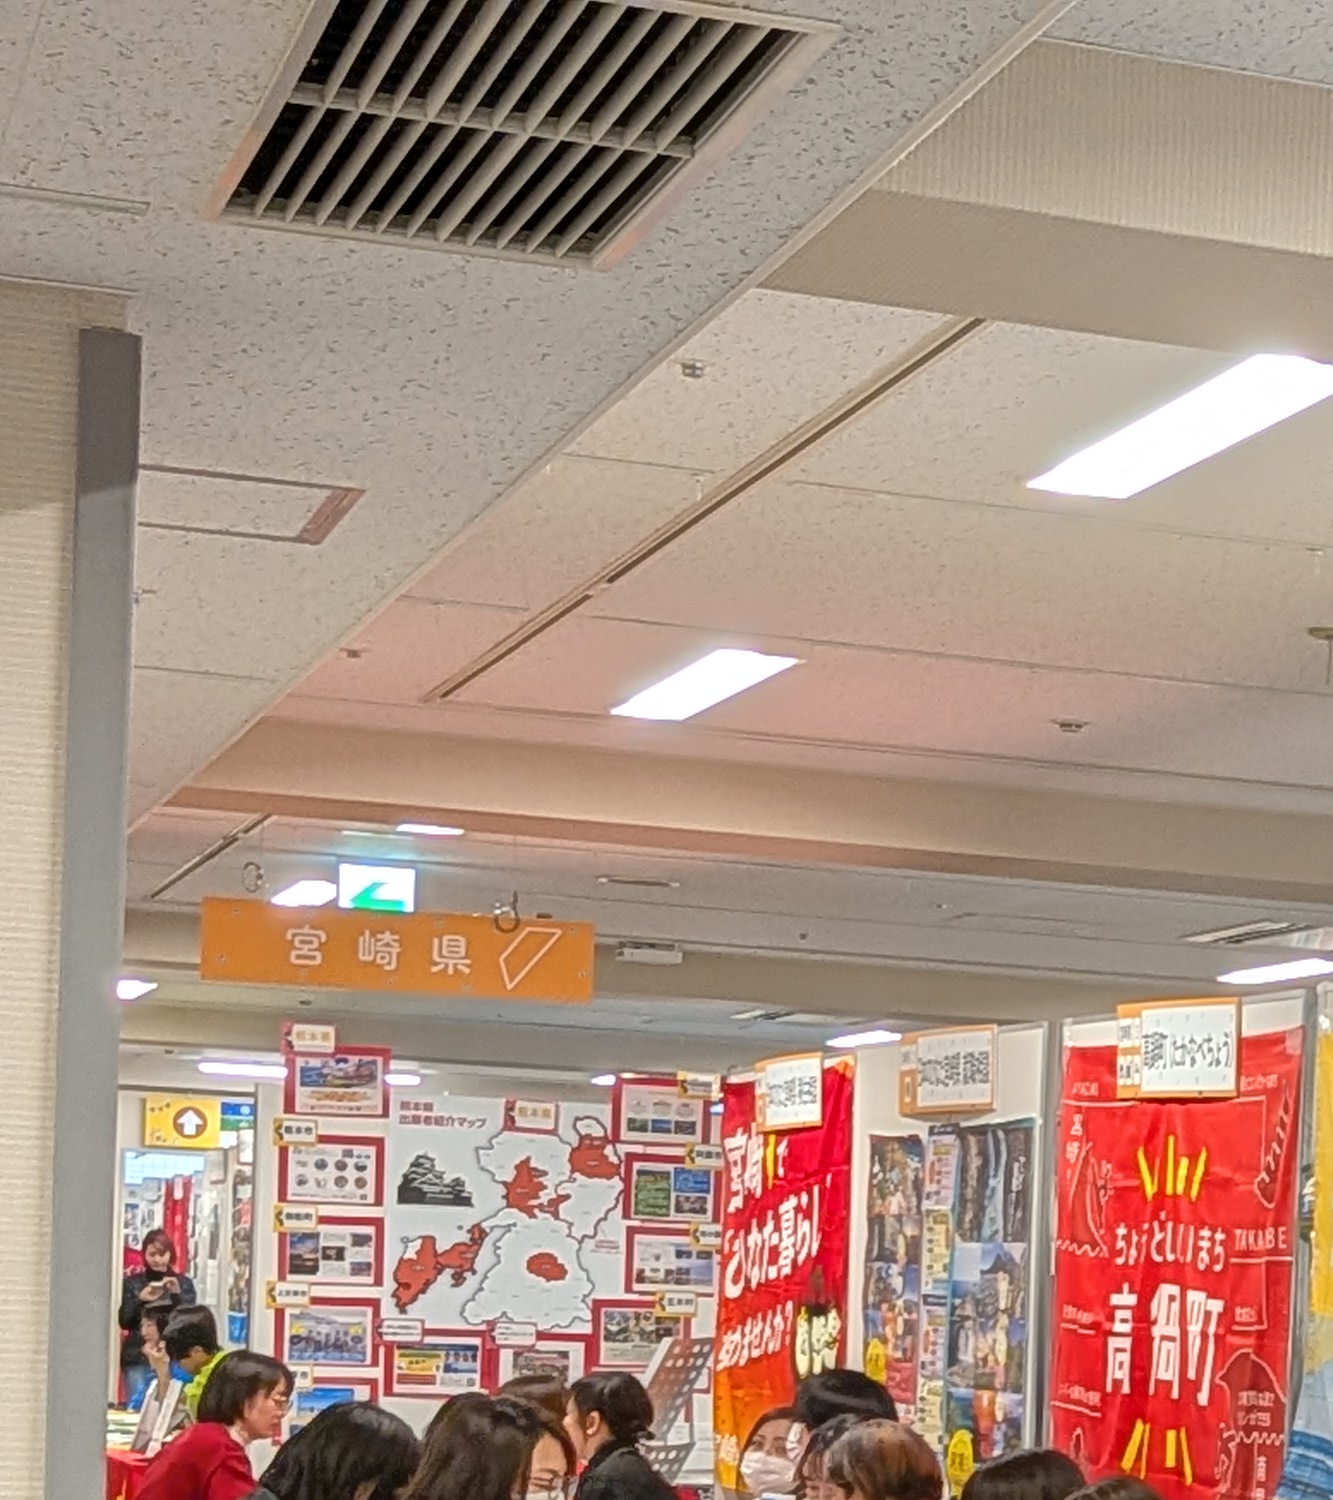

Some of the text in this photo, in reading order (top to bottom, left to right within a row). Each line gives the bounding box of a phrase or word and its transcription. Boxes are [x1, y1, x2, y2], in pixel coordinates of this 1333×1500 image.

[285, 924, 472, 976] 宮崎県
[1105, 1281, 1226, 1407] 高鍋町
